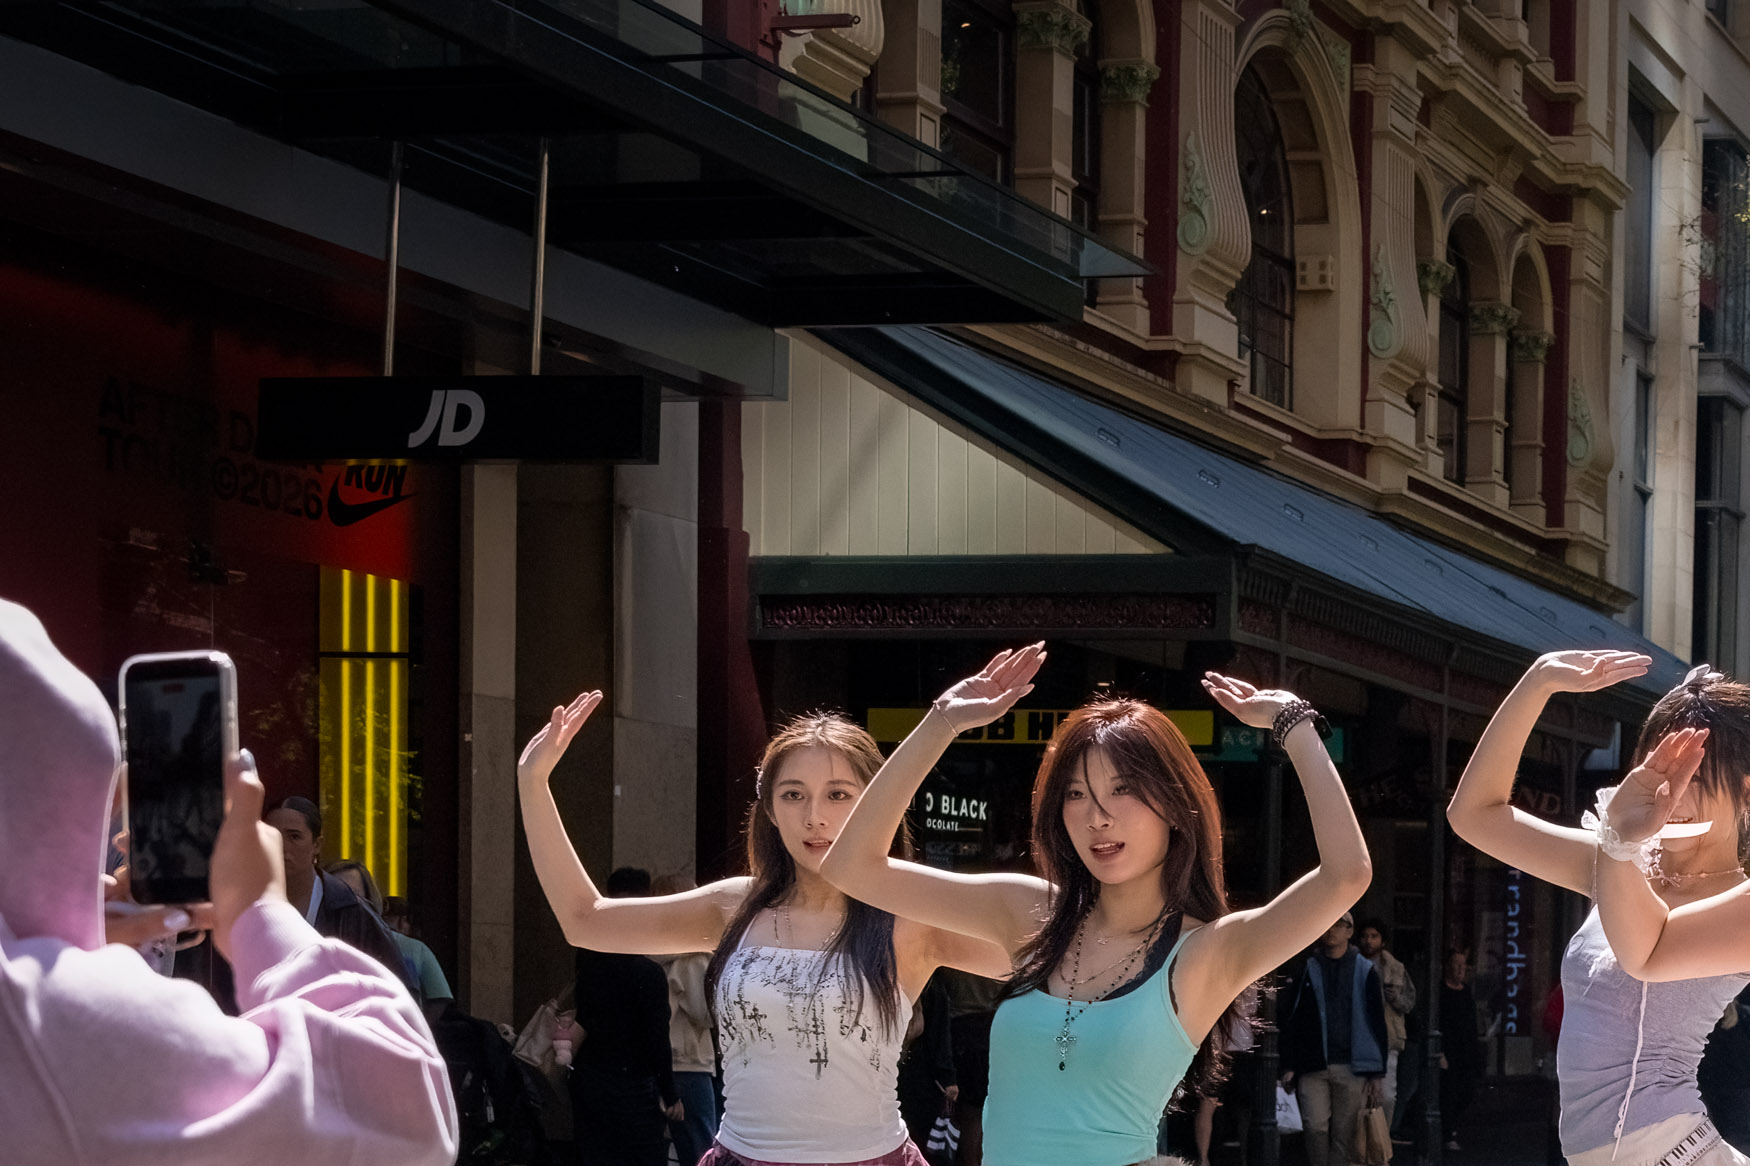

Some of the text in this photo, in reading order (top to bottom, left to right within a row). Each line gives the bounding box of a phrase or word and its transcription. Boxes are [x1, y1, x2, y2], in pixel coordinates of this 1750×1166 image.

[407, 388, 486, 448] JD
[344, 462, 408, 498] RUN
[926, 817, 959, 832] OCOLATE
[941, 794, 988, 821] BLACK
[1506, 868, 1527, 1035] trandbags
